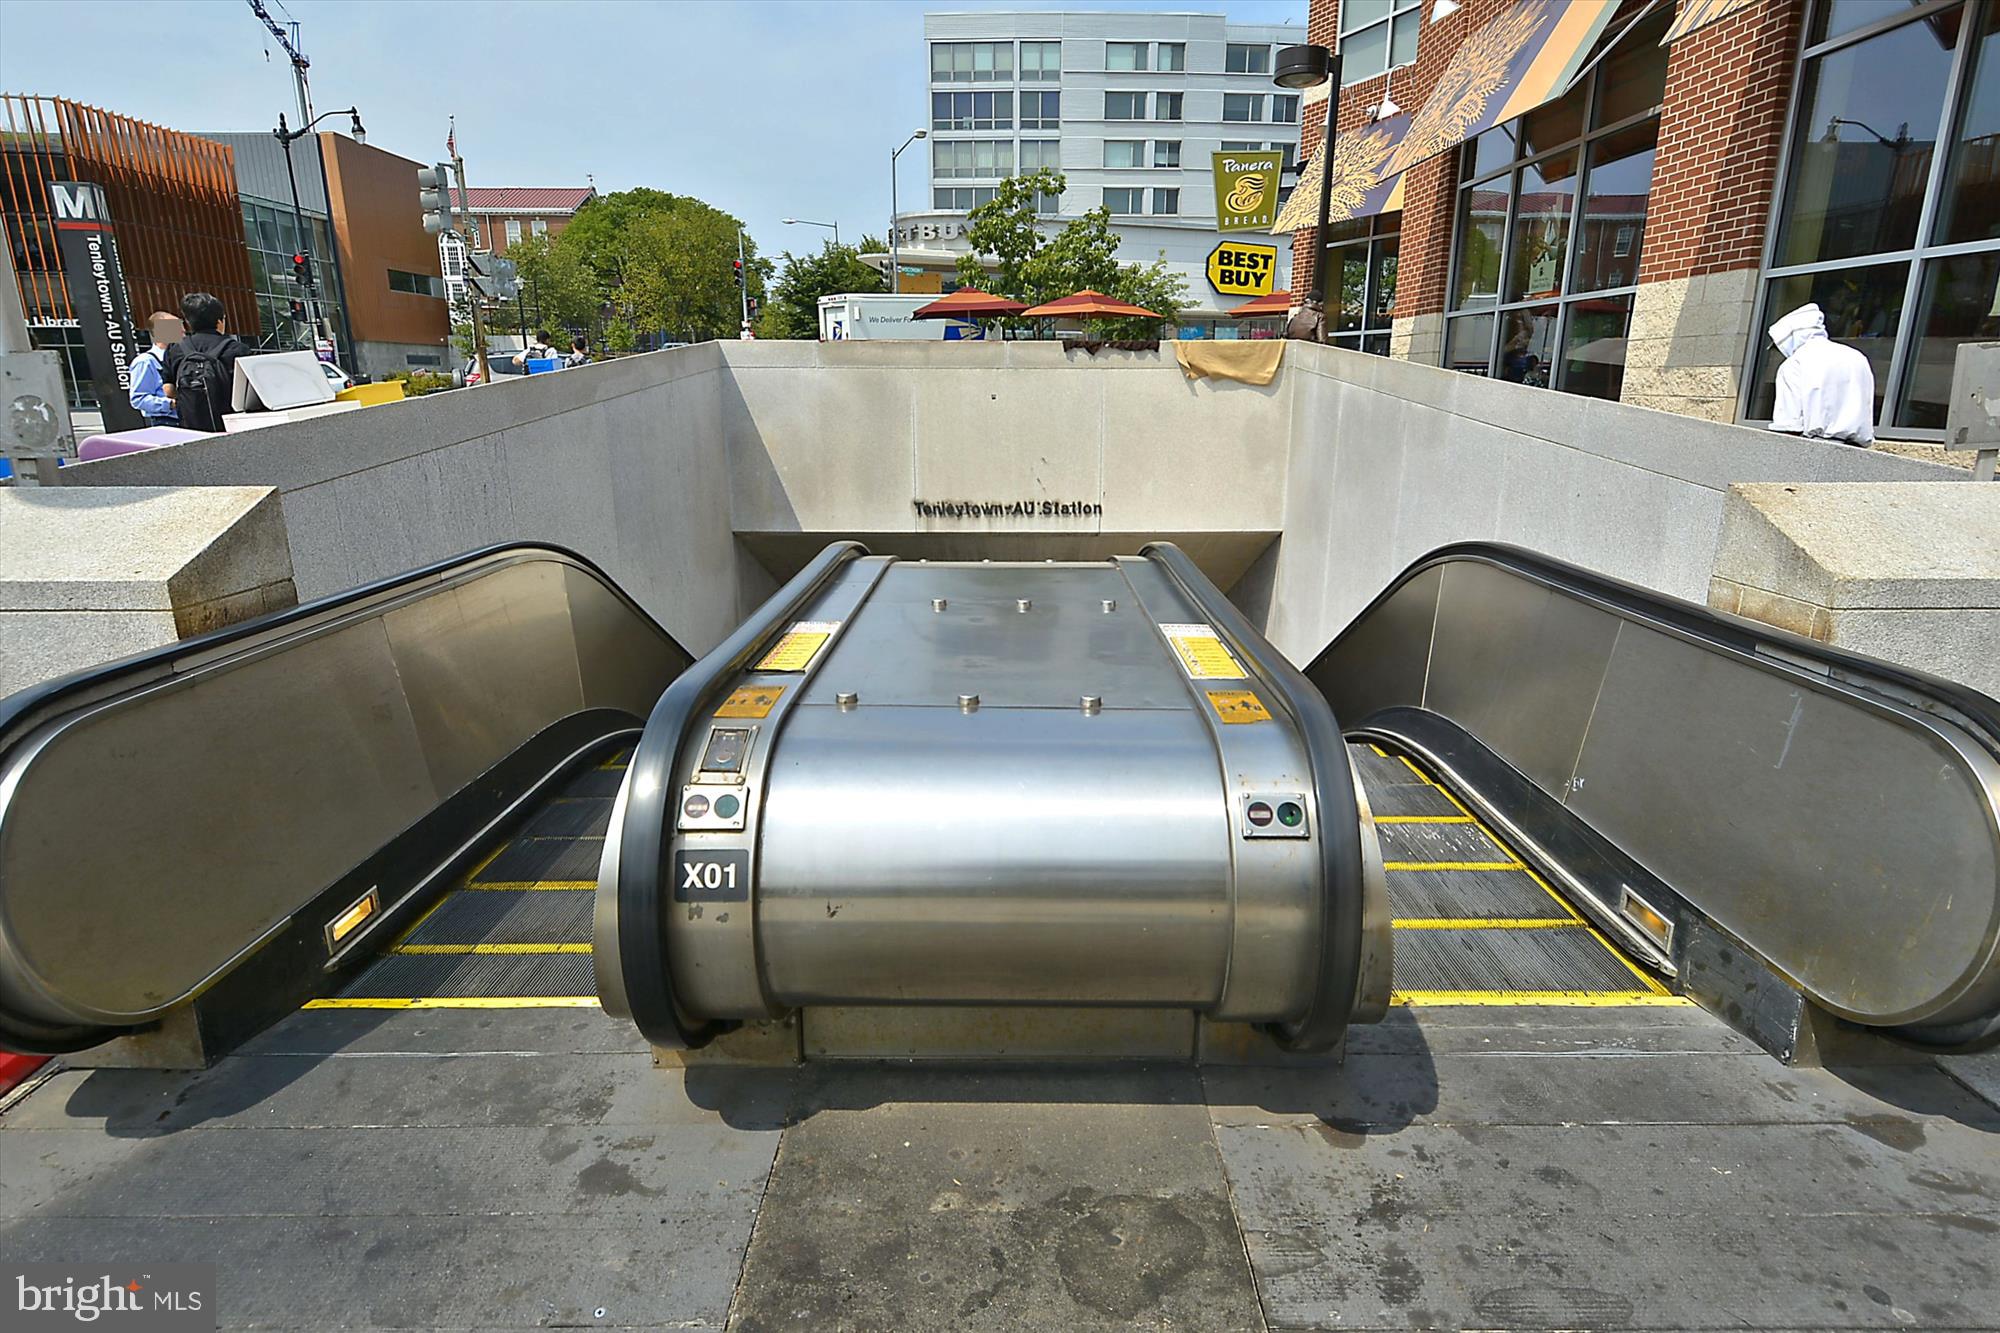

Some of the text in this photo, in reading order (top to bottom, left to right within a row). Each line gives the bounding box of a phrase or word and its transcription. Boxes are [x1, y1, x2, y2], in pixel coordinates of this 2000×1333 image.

[1223, 159, 1273, 173] Panera
[51, 185, 97, 219] M
[1224, 215, 1268, 226] BREAD
[1218, 250, 1273, 270] BEST
[1220, 269, 1266, 288] BUY
[33, 315, 80, 328] Librar
[86, 234, 130, 390] Tenleytown-AU Station
[1042, 501, 1102, 516] Station
[682, 862, 736, 889] X01
